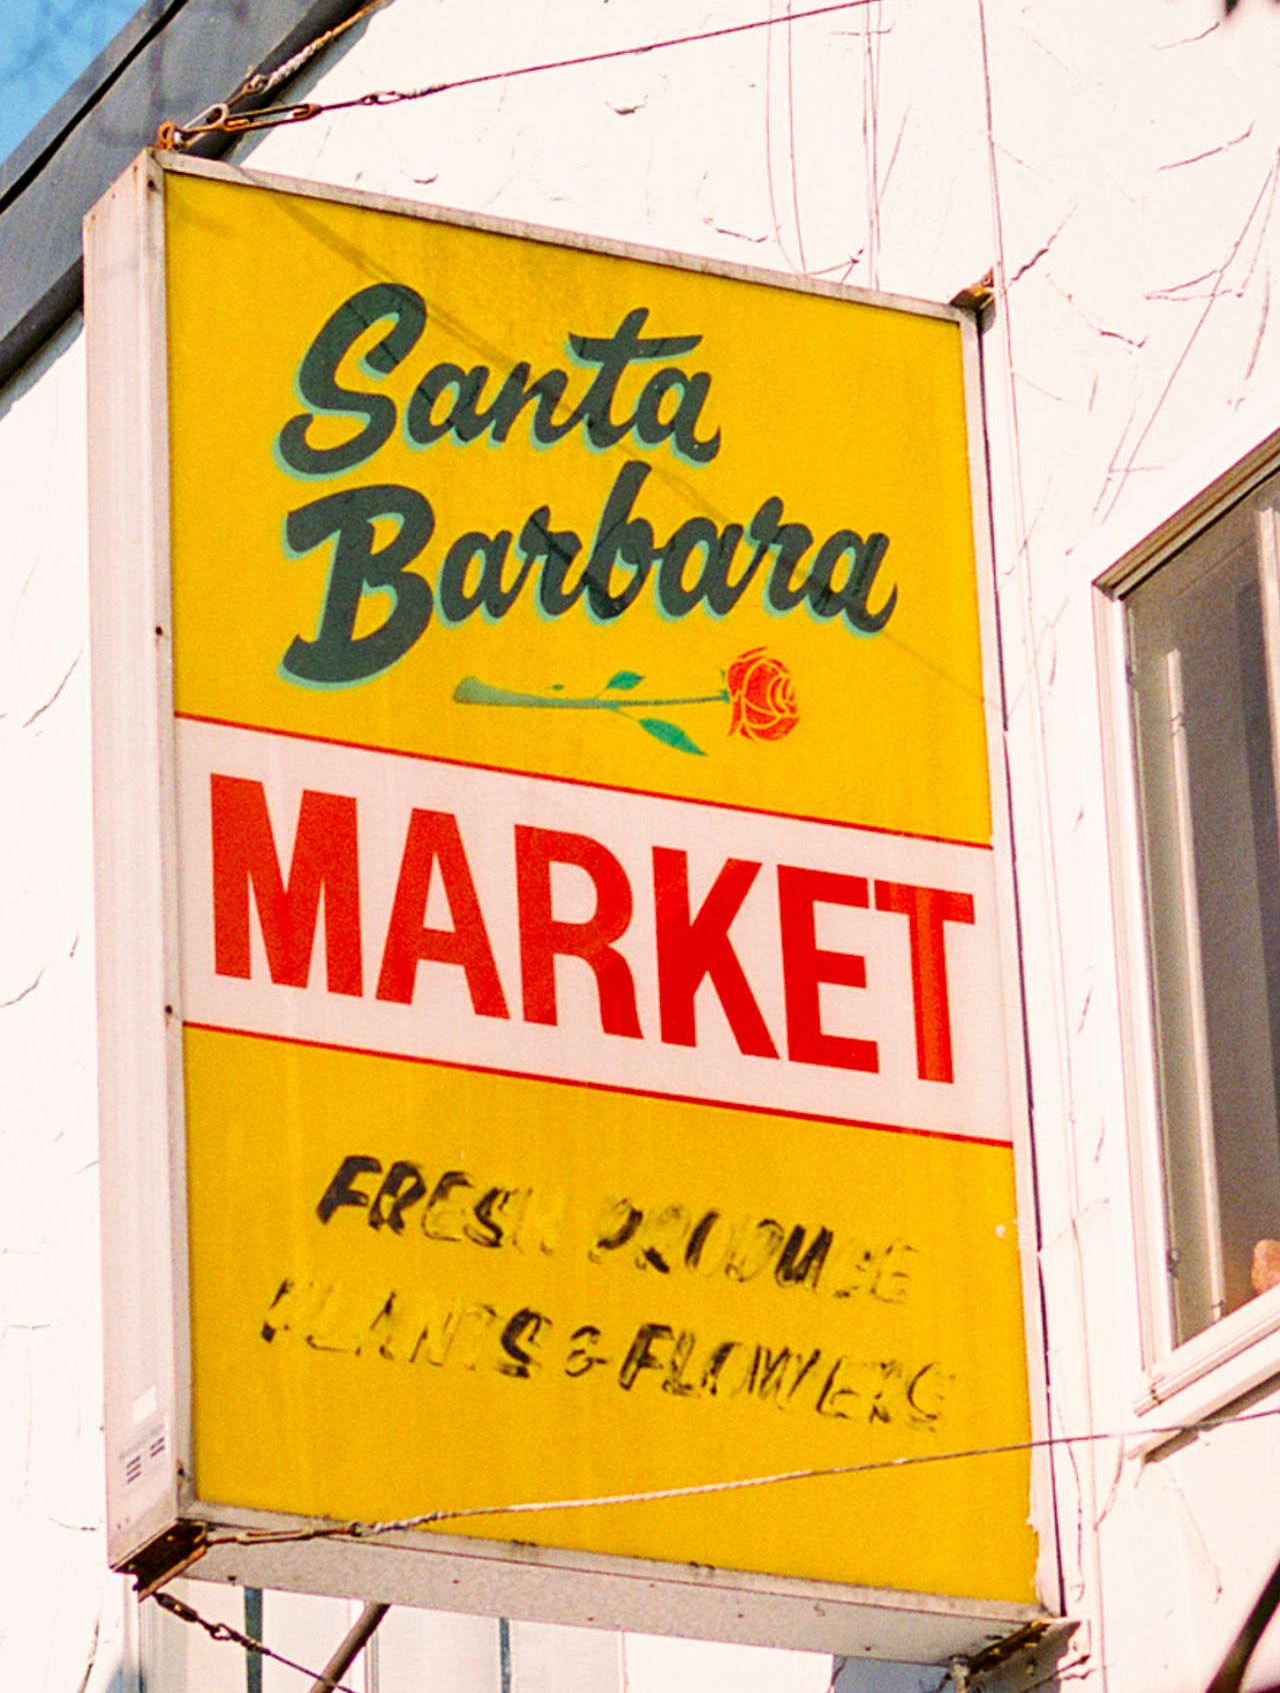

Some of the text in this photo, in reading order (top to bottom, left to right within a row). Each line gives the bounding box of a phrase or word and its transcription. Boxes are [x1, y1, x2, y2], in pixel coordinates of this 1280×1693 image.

[273, 282, 721, 481] Santa
[276, 460, 898, 691] Barbara
[209, 773, 976, 1084] MARKET
[260, 1276, 554, 1379] PLANS
[315, 1154, 920, 1305] FRES PRODUE
